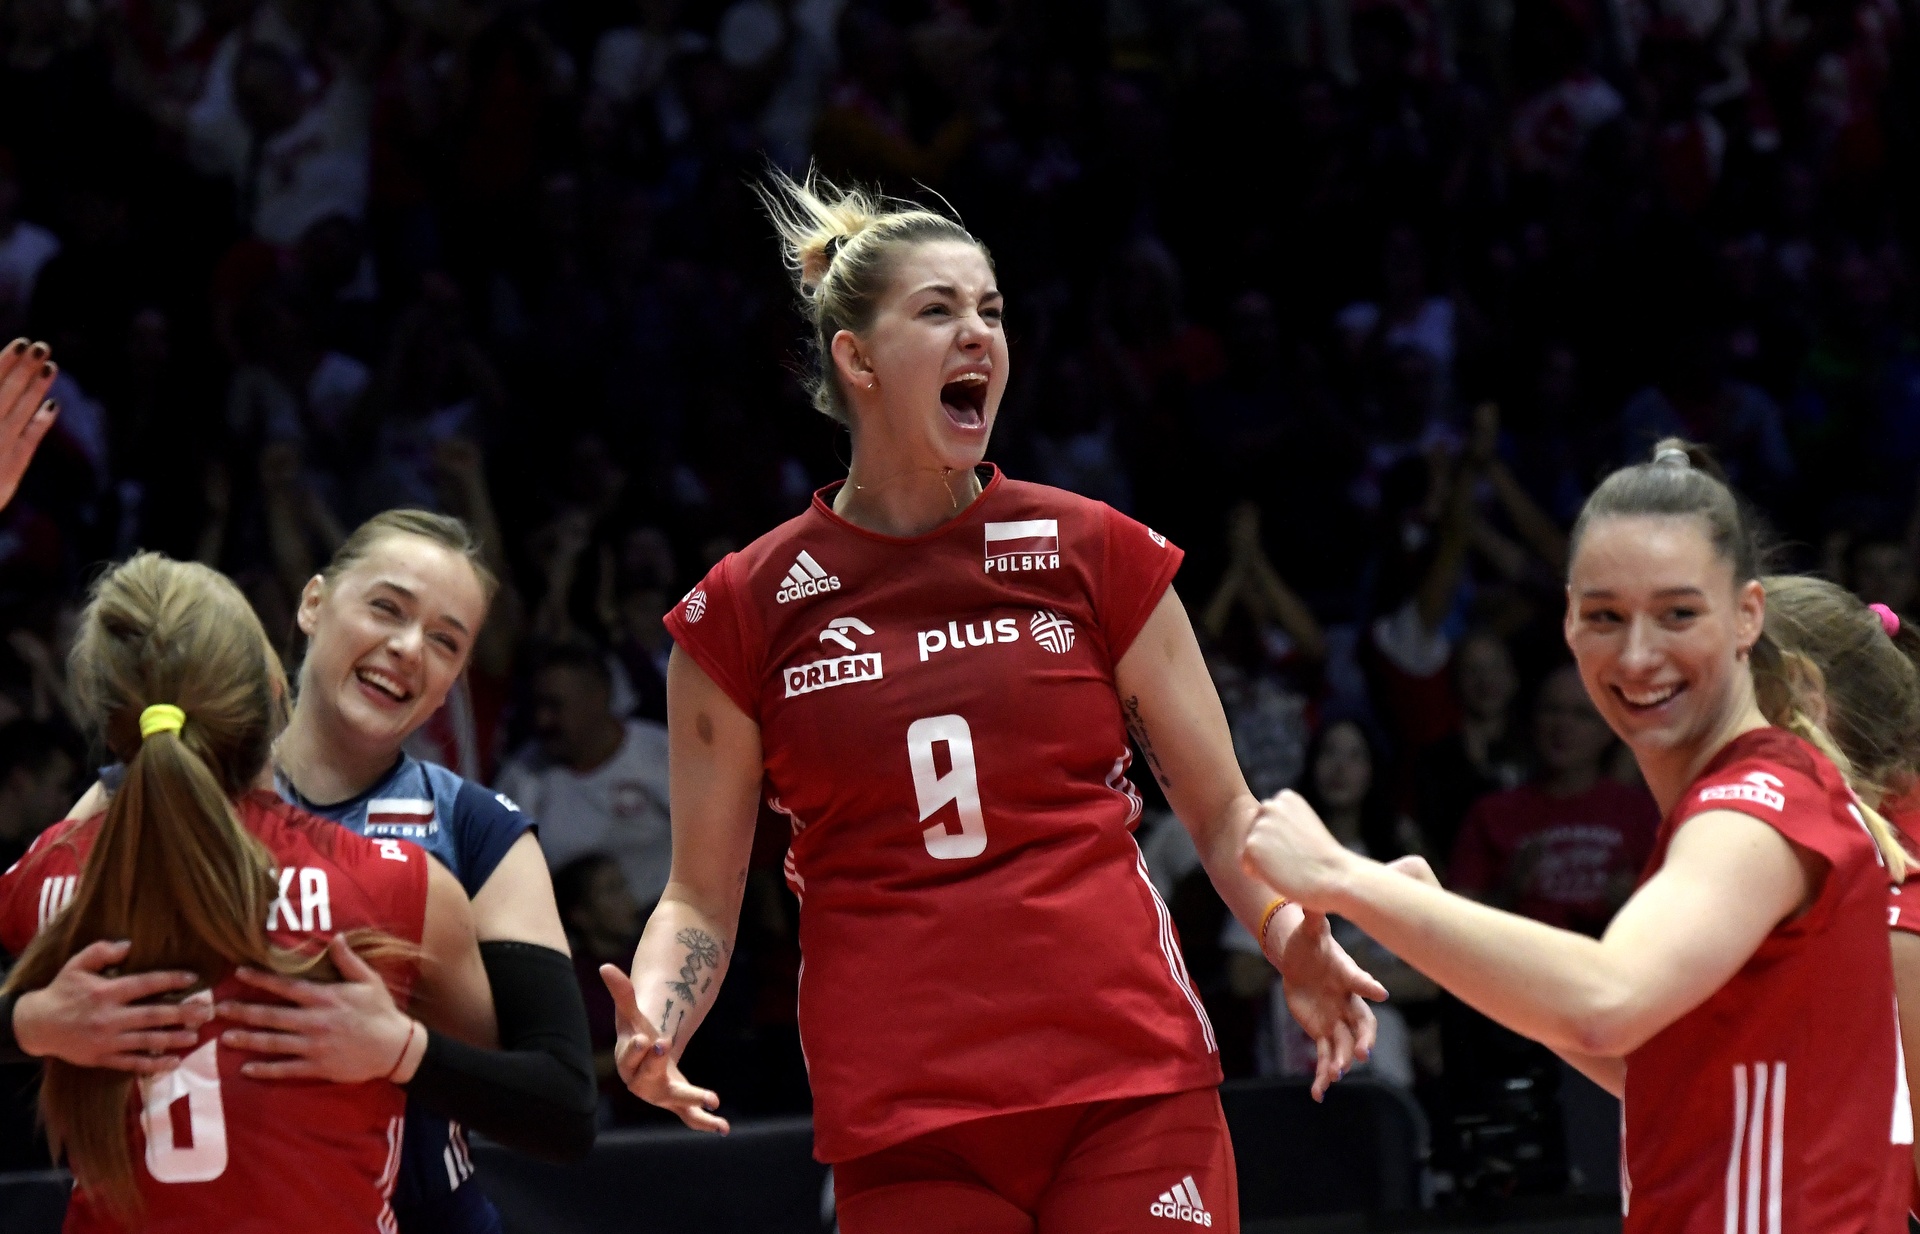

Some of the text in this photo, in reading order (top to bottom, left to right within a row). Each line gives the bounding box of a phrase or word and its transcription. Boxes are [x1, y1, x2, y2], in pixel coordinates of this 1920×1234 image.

[984, 554, 1060, 574] POLSKA
[776, 576, 841, 604] adidas
[917, 617, 1019, 662] plus
[789, 658, 877, 692] ORLEN
[907, 714, 988, 860] 9
[1150, 1202, 1212, 1227] adidas
